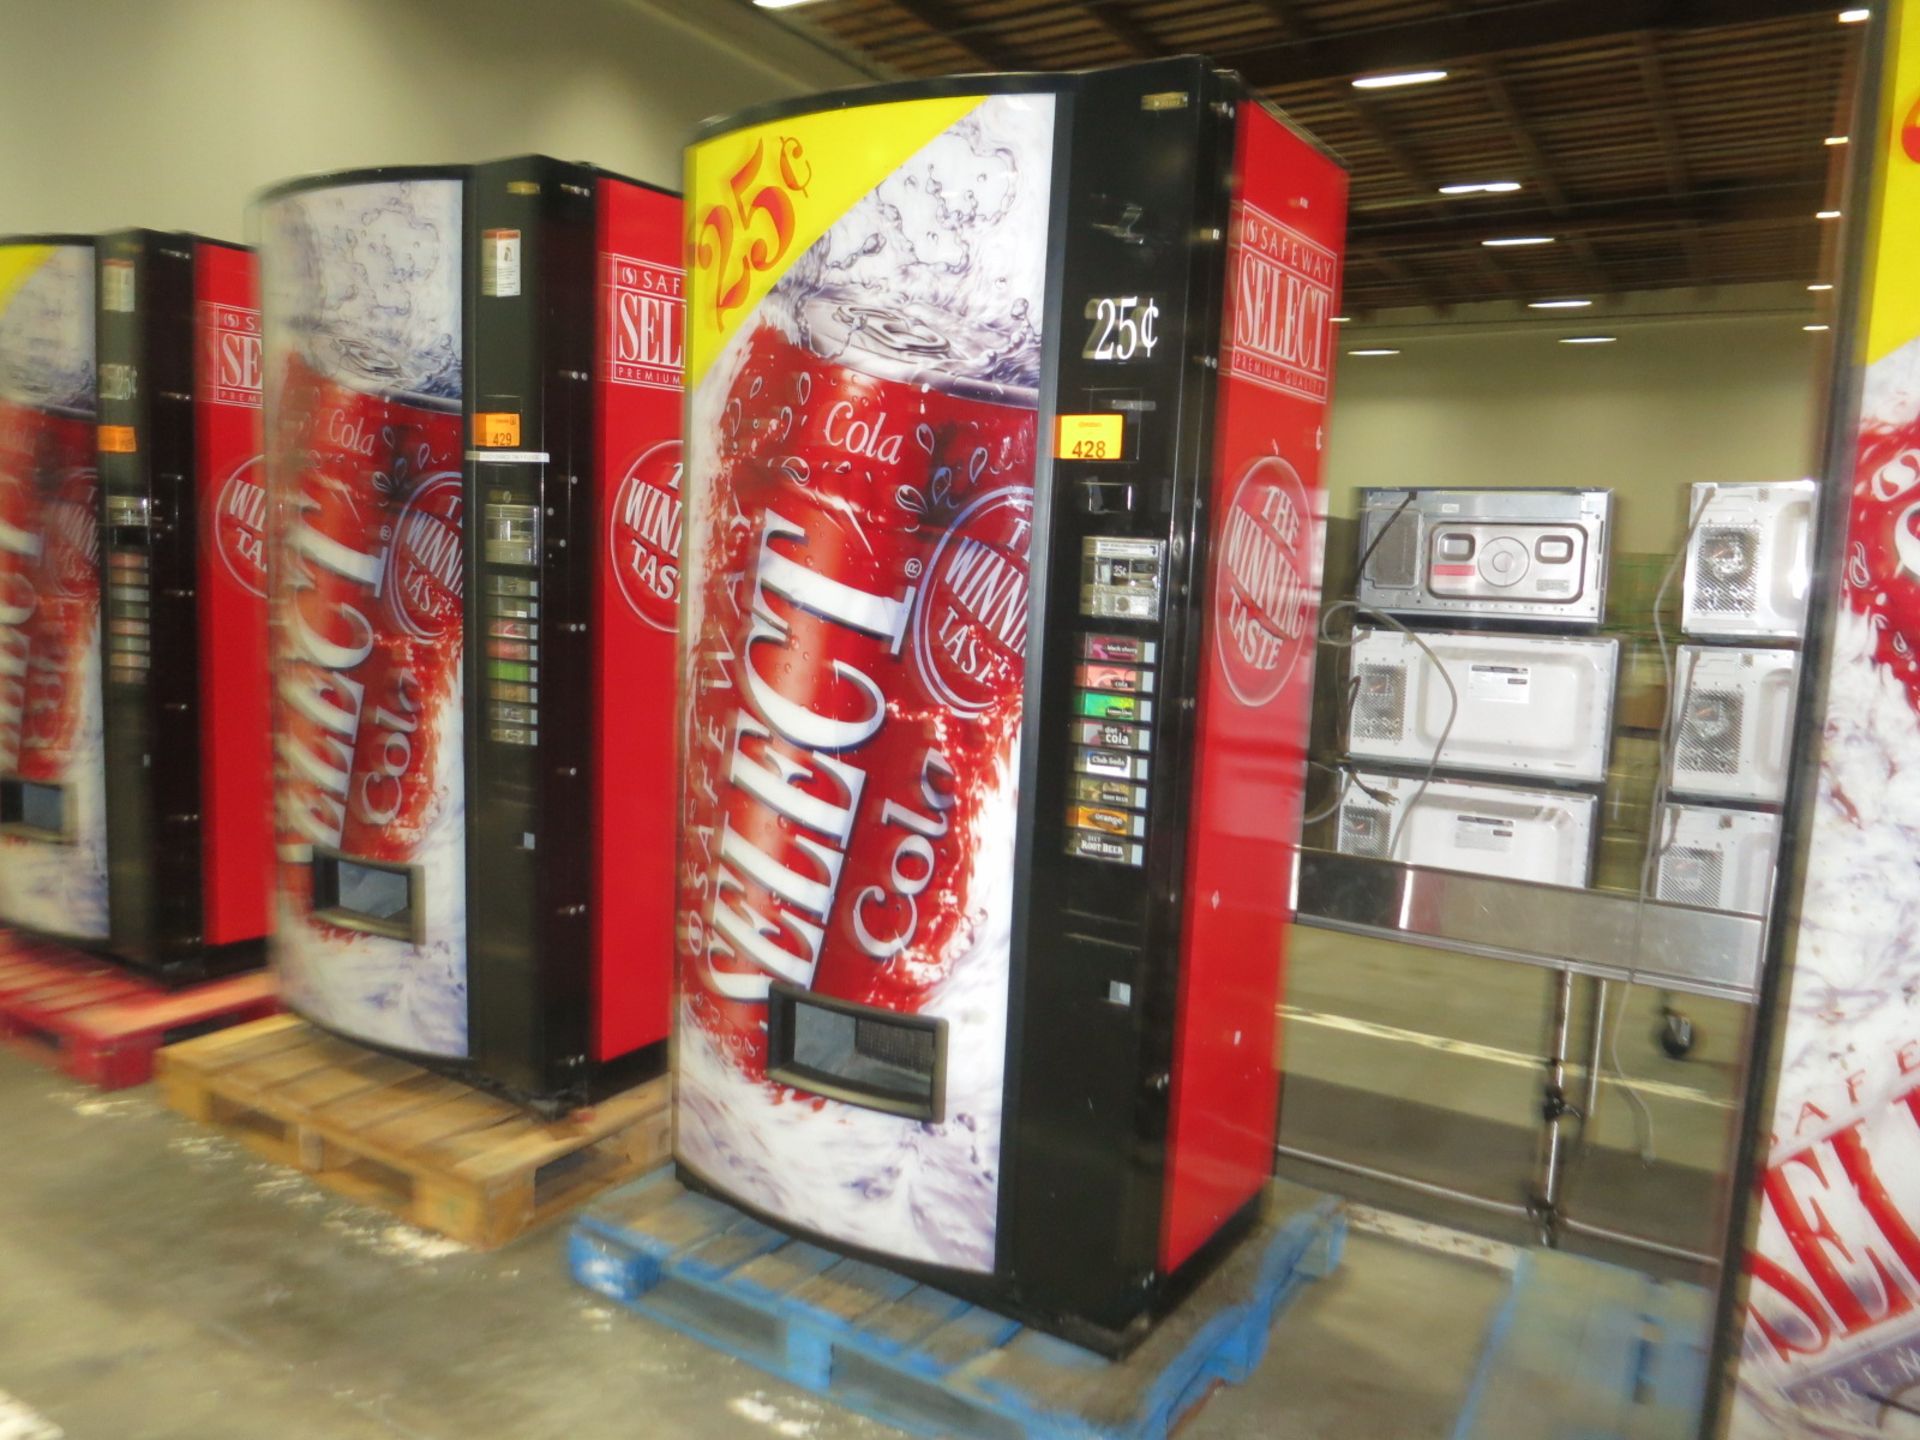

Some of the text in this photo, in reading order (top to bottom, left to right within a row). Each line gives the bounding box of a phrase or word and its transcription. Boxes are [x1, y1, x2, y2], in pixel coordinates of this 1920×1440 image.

[697, 136, 812, 334] 25¢
[1261, 225, 1332, 283] SAFEWAY
[1094, 296, 1159, 361] 25¢
[1238, 254, 1328, 372] SELECT
[329, 410, 376, 457] Cola
[493, 432, 512, 446] 429
[824, 400, 903, 466] Cola
[1072, 440, 1106, 459] 428
[1262, 485, 1299, 557] THE
[1228, 505, 1308, 641] WINNING
[1228, 586, 1284, 671] TASTE
[1106, 731, 1128, 745] cola
[853, 747, 956, 959] Cola
